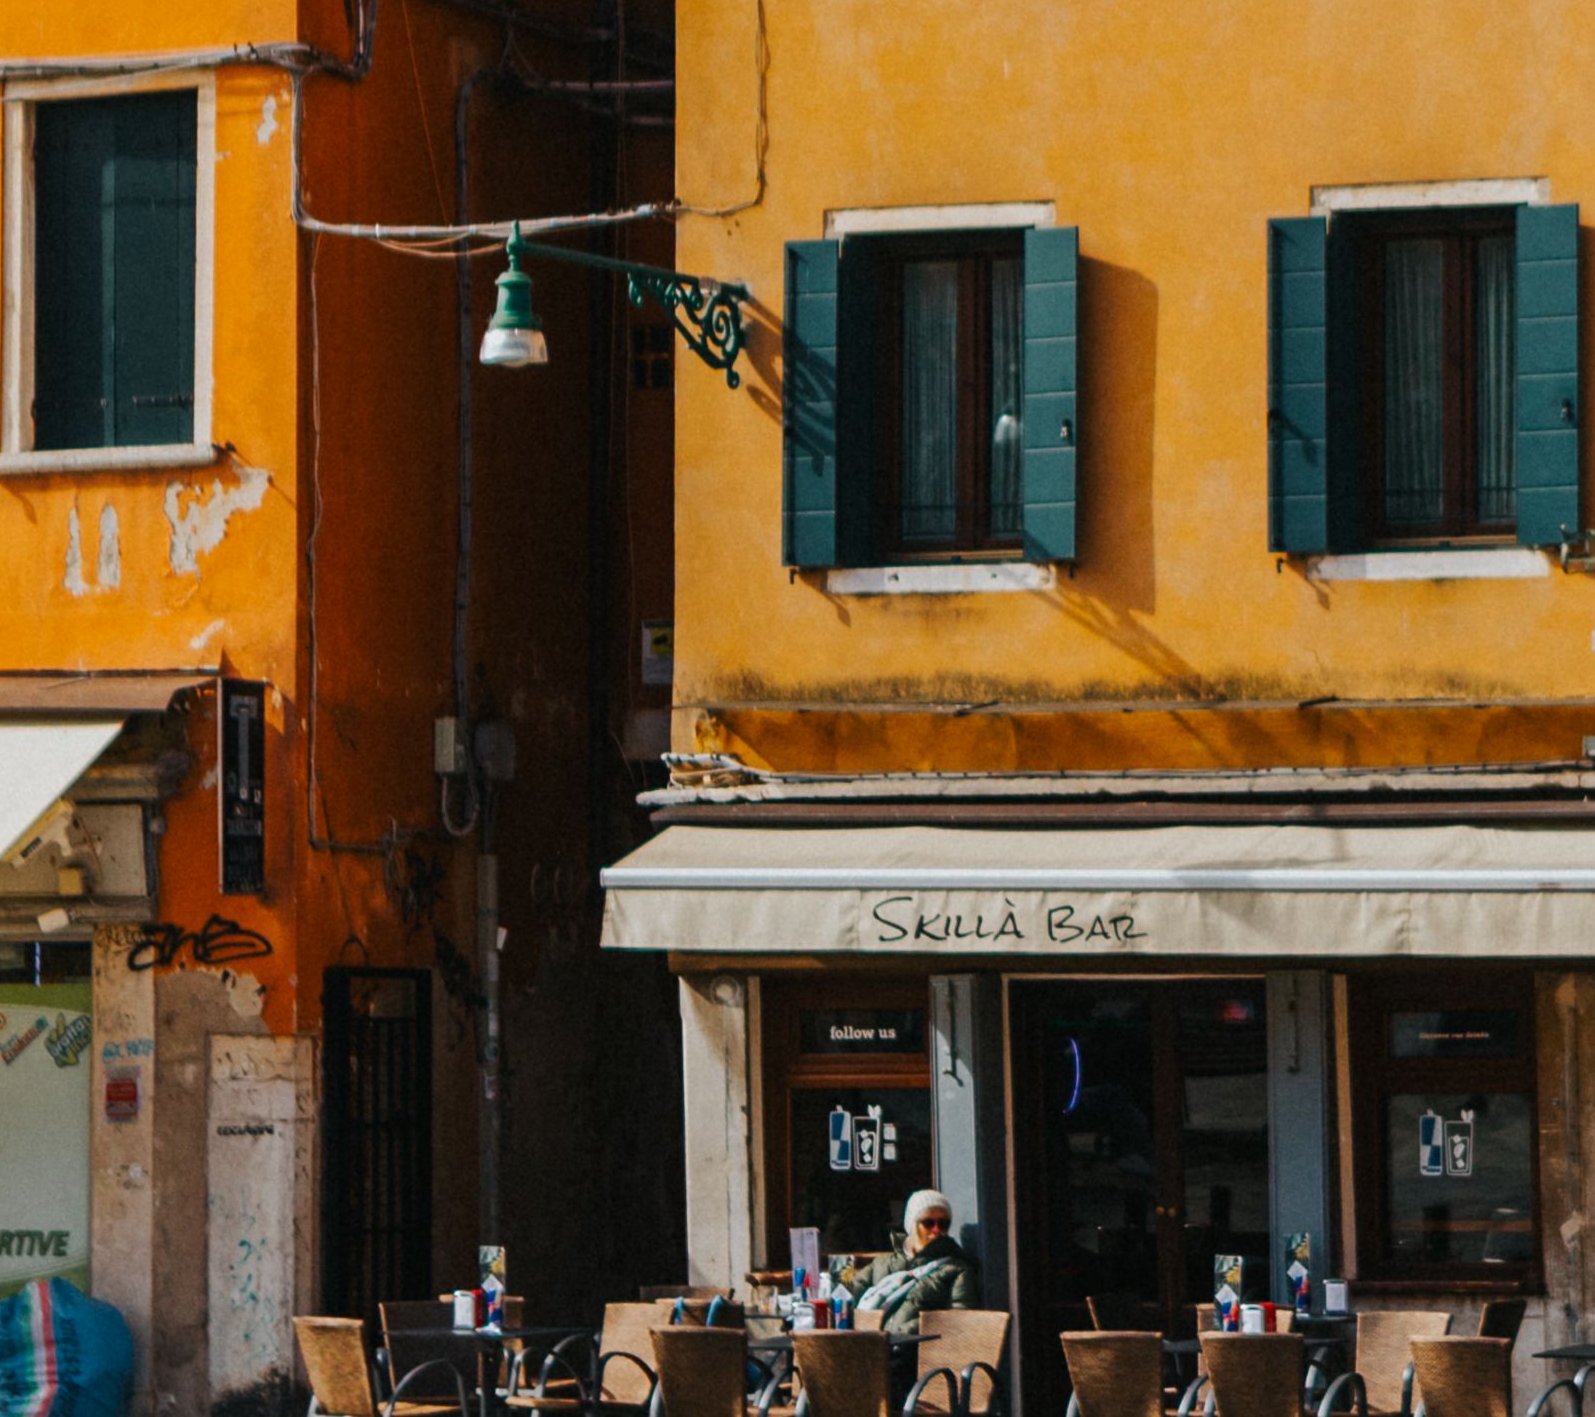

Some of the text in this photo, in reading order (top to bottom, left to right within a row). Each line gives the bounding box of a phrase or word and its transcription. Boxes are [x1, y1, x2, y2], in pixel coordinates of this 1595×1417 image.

[1047, 904, 1149, 943] BAR
[829, 1025, 897, 1040] follow us
